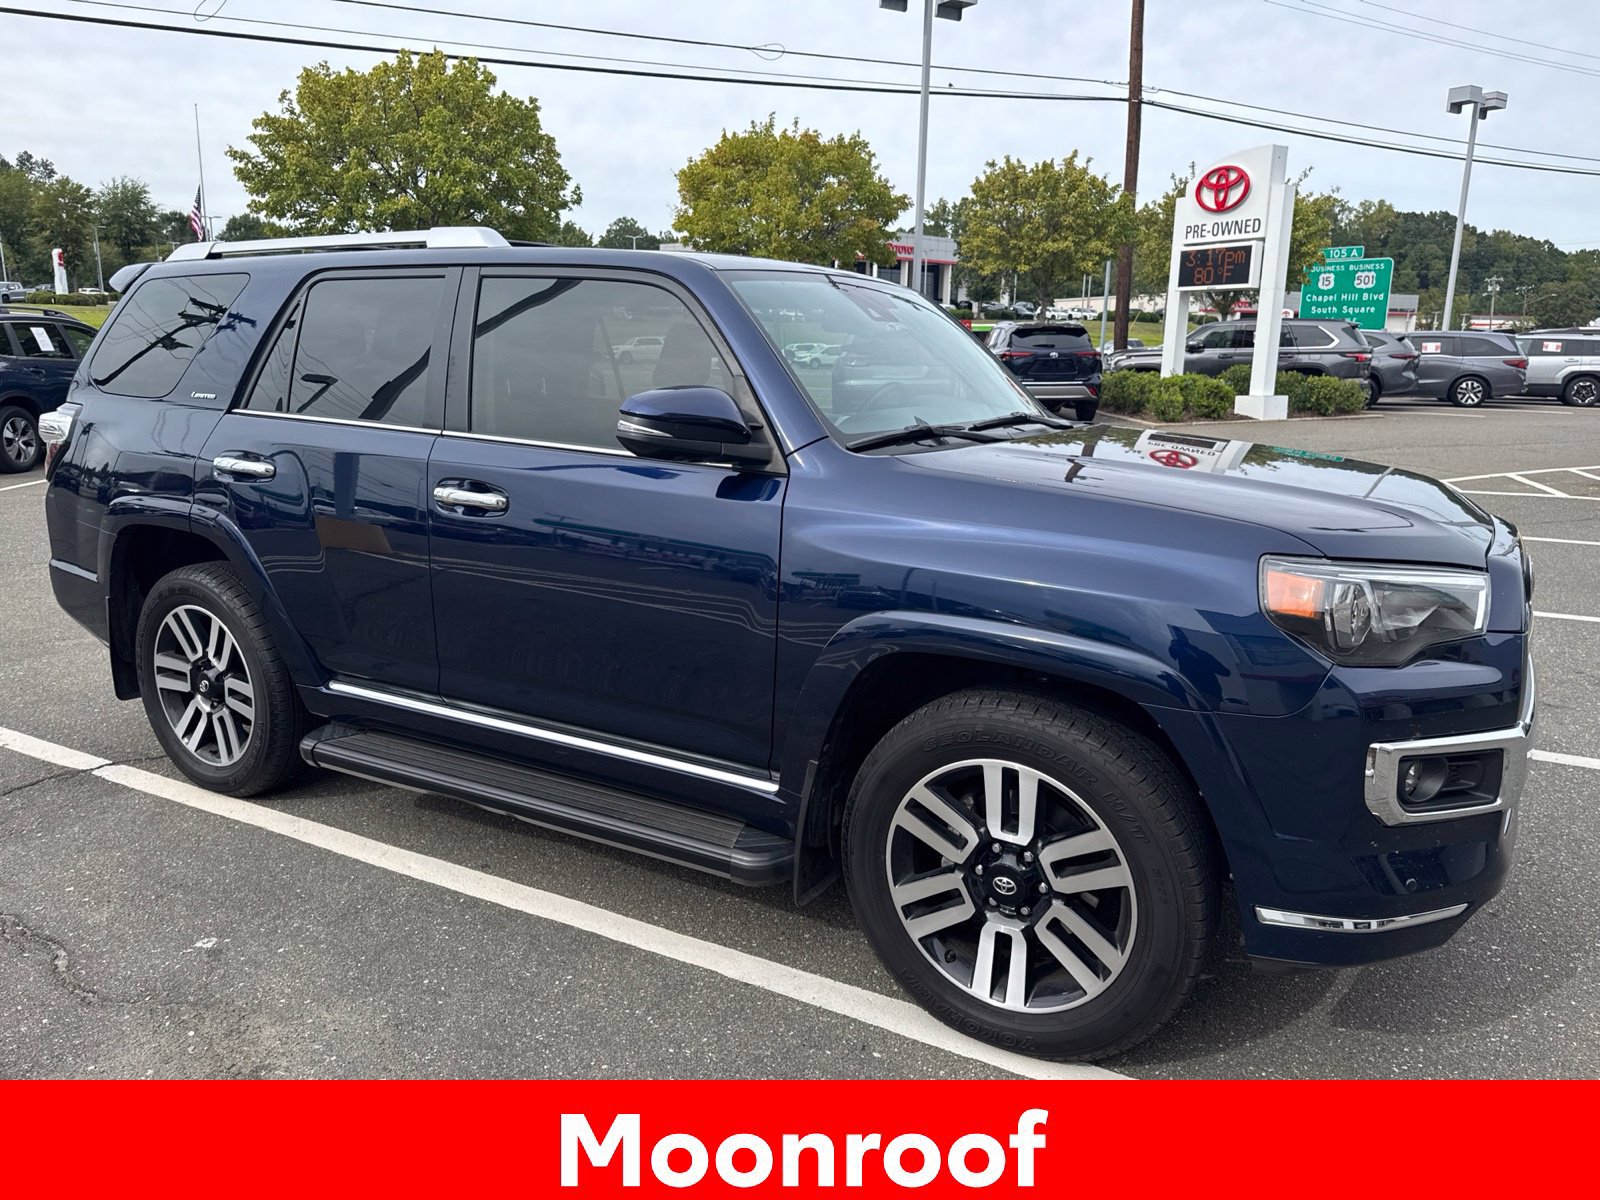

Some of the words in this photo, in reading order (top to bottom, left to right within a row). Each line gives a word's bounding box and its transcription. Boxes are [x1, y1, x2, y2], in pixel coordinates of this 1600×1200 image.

[1185, 218, 1261, 239] PRE-OWNED
[1330, 249, 1347, 258] 105
[1350, 248, 1358, 257] A
[1349, 263, 1385, 271] BUSINESS
[1322, 276, 1331, 287] 15
[1356, 275, 1374, 286] 501
[1305, 294, 1337, 302] Chapel
[1341, 293, 1358, 301] Hill
[1362, 292, 1384, 301] Blvd
[1311, 306, 1337, 314] South
[1342, 305, 1375, 315] Square
[922, 728, 1098, 787] GEOLANDAR
